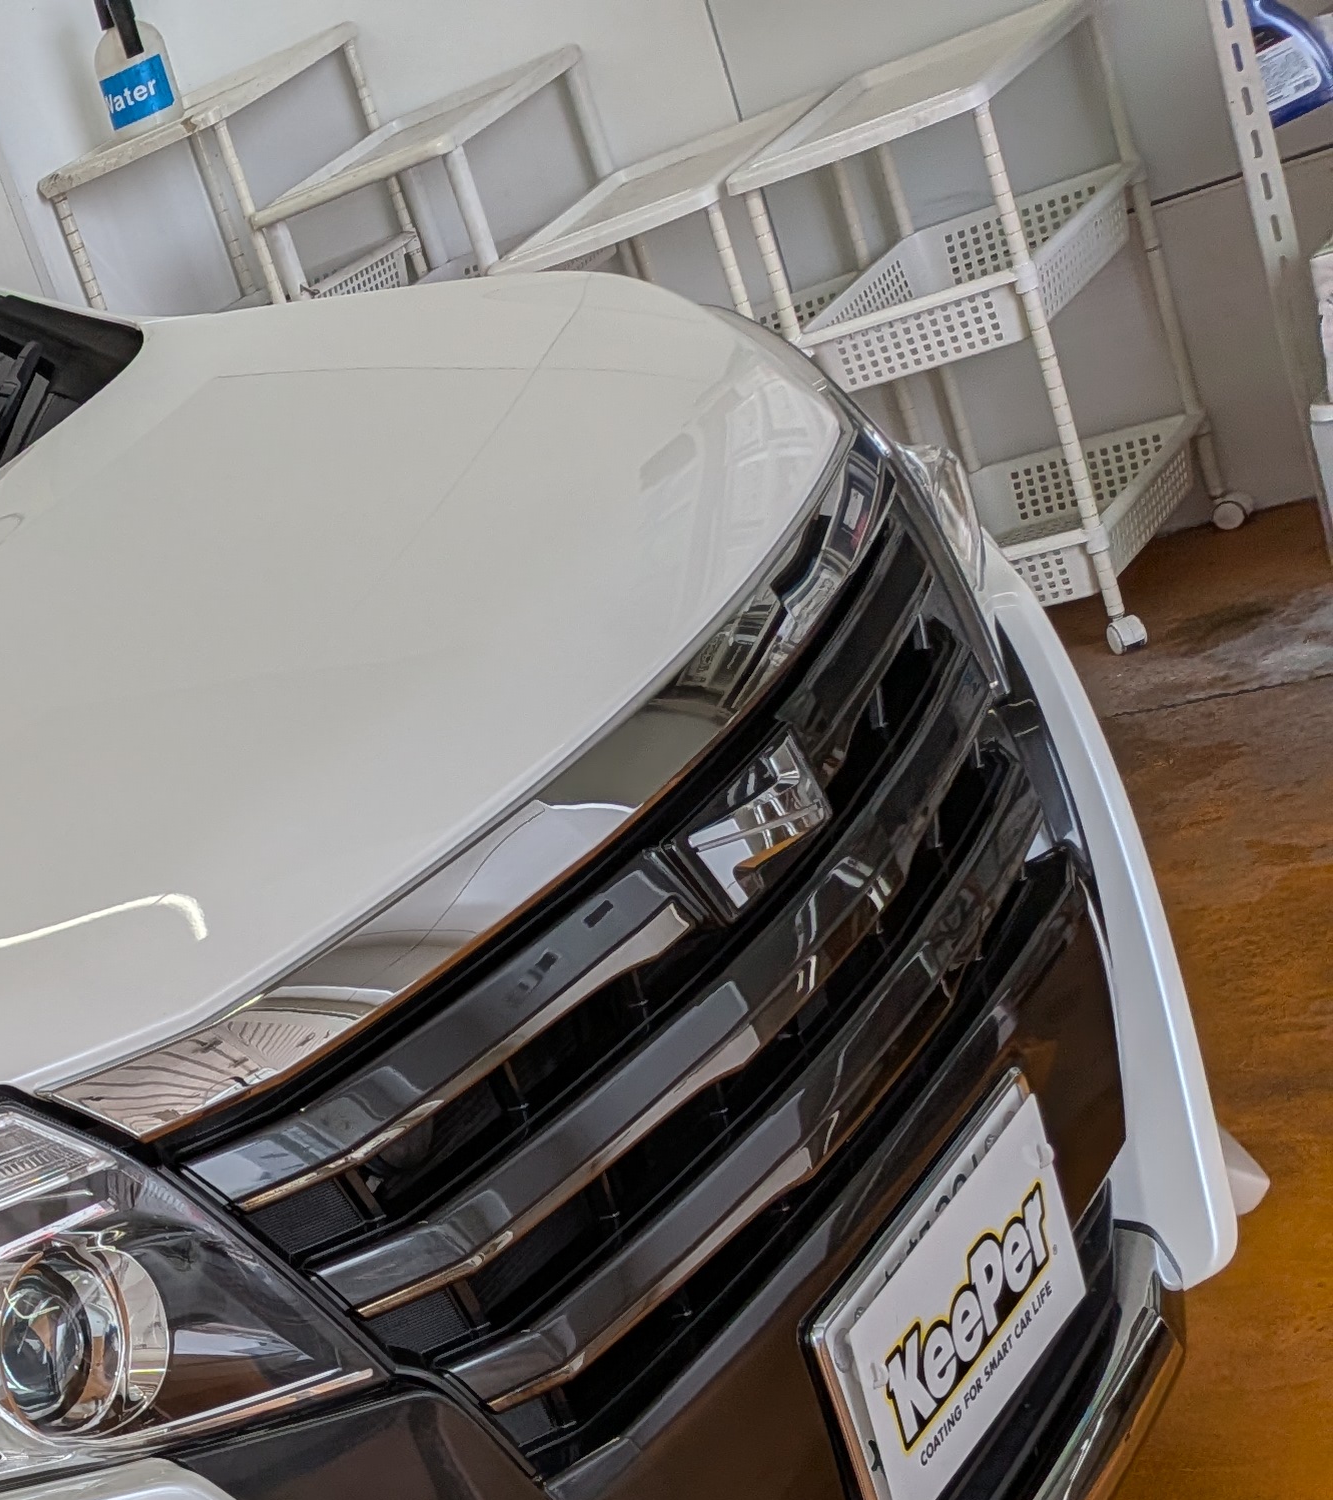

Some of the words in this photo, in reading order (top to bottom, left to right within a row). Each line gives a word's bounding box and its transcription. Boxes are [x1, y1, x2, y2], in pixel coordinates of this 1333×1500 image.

[885, 1182, 1050, 1452] KeePer
[920, 1408, 963, 1467] COATING
[964, 1379, 983, 1411] FOR
[984, 1334, 1014, 1382] SMART
[1014, 1311, 1033, 1340] CAR
[1032, 1280, 1053, 1317] LIFE
